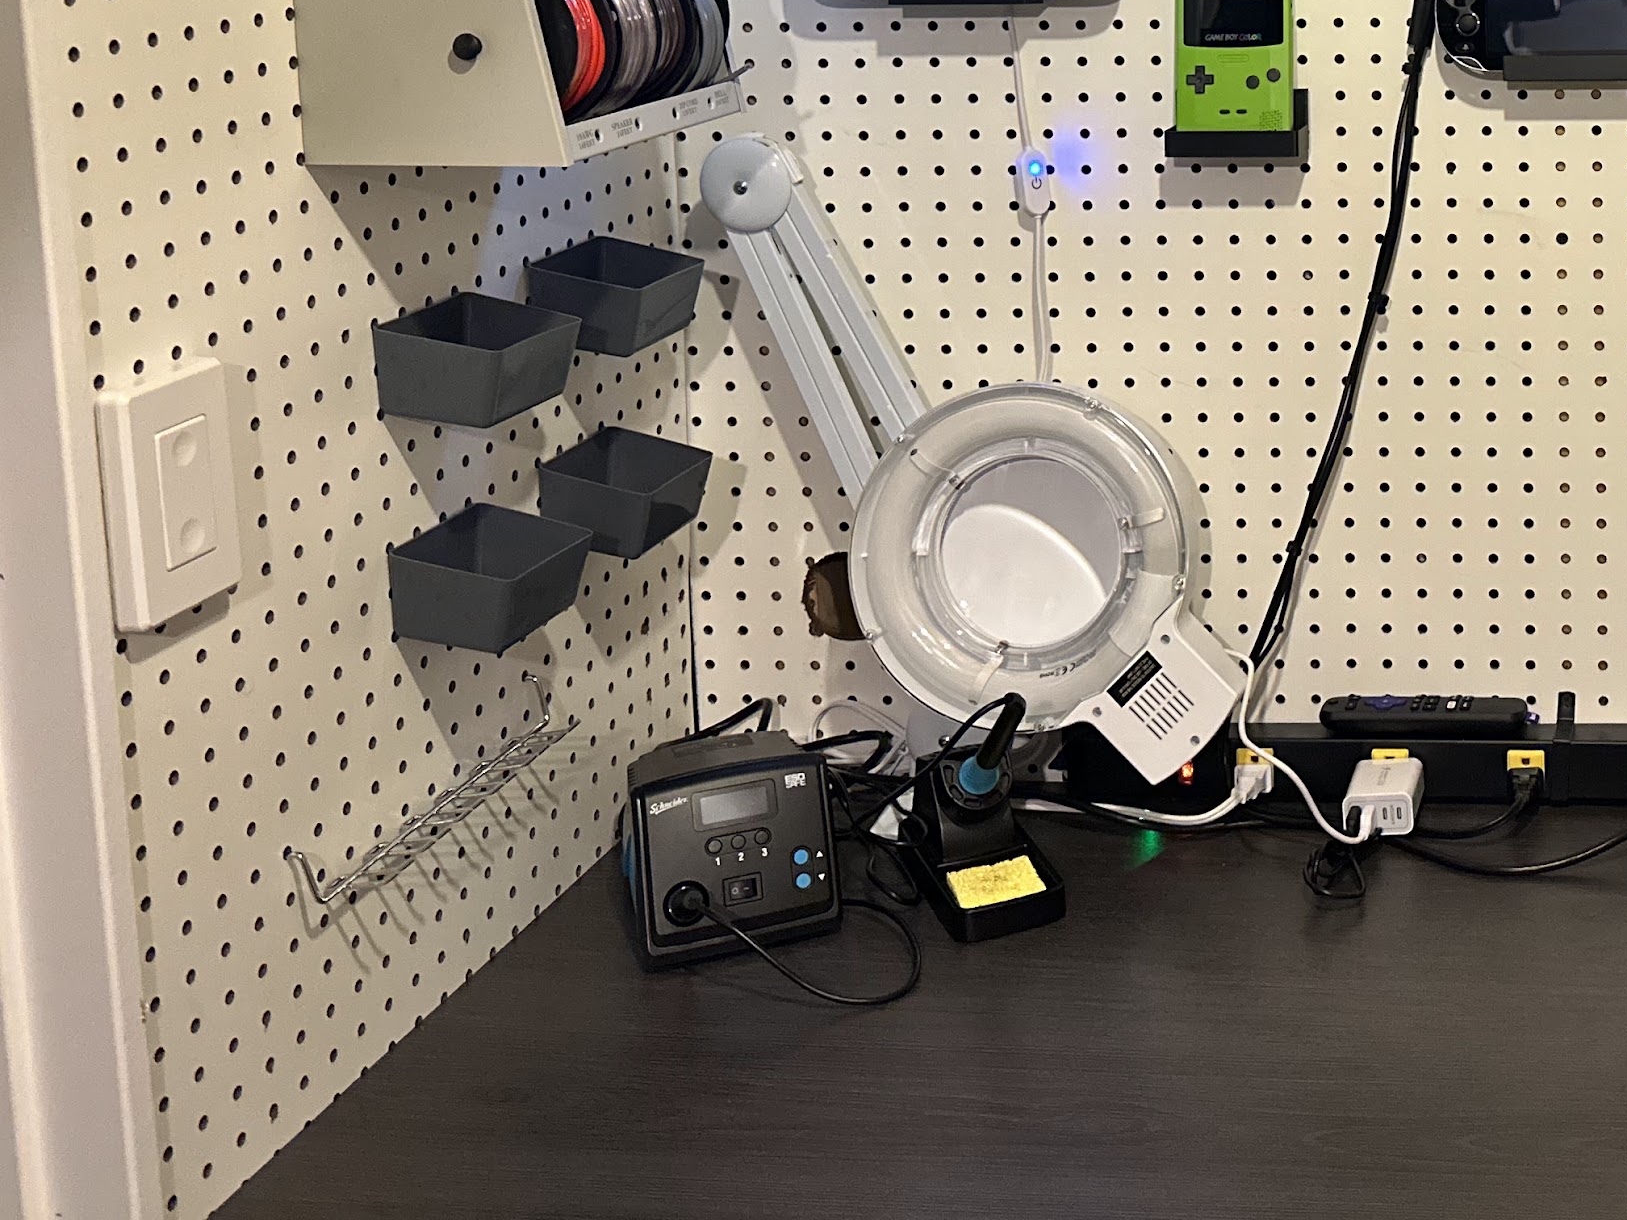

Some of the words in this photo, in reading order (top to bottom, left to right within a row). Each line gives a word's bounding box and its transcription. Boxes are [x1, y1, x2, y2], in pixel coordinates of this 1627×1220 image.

[1204, 33, 1225, 41] GAME
[1225, 33, 1238, 41] BOY
[1238, 32, 1262, 41] COLOR
[715, 857, 721, 866] 1
[738, 852, 745, 862] 2
[761, 847, 768, 857] 3
